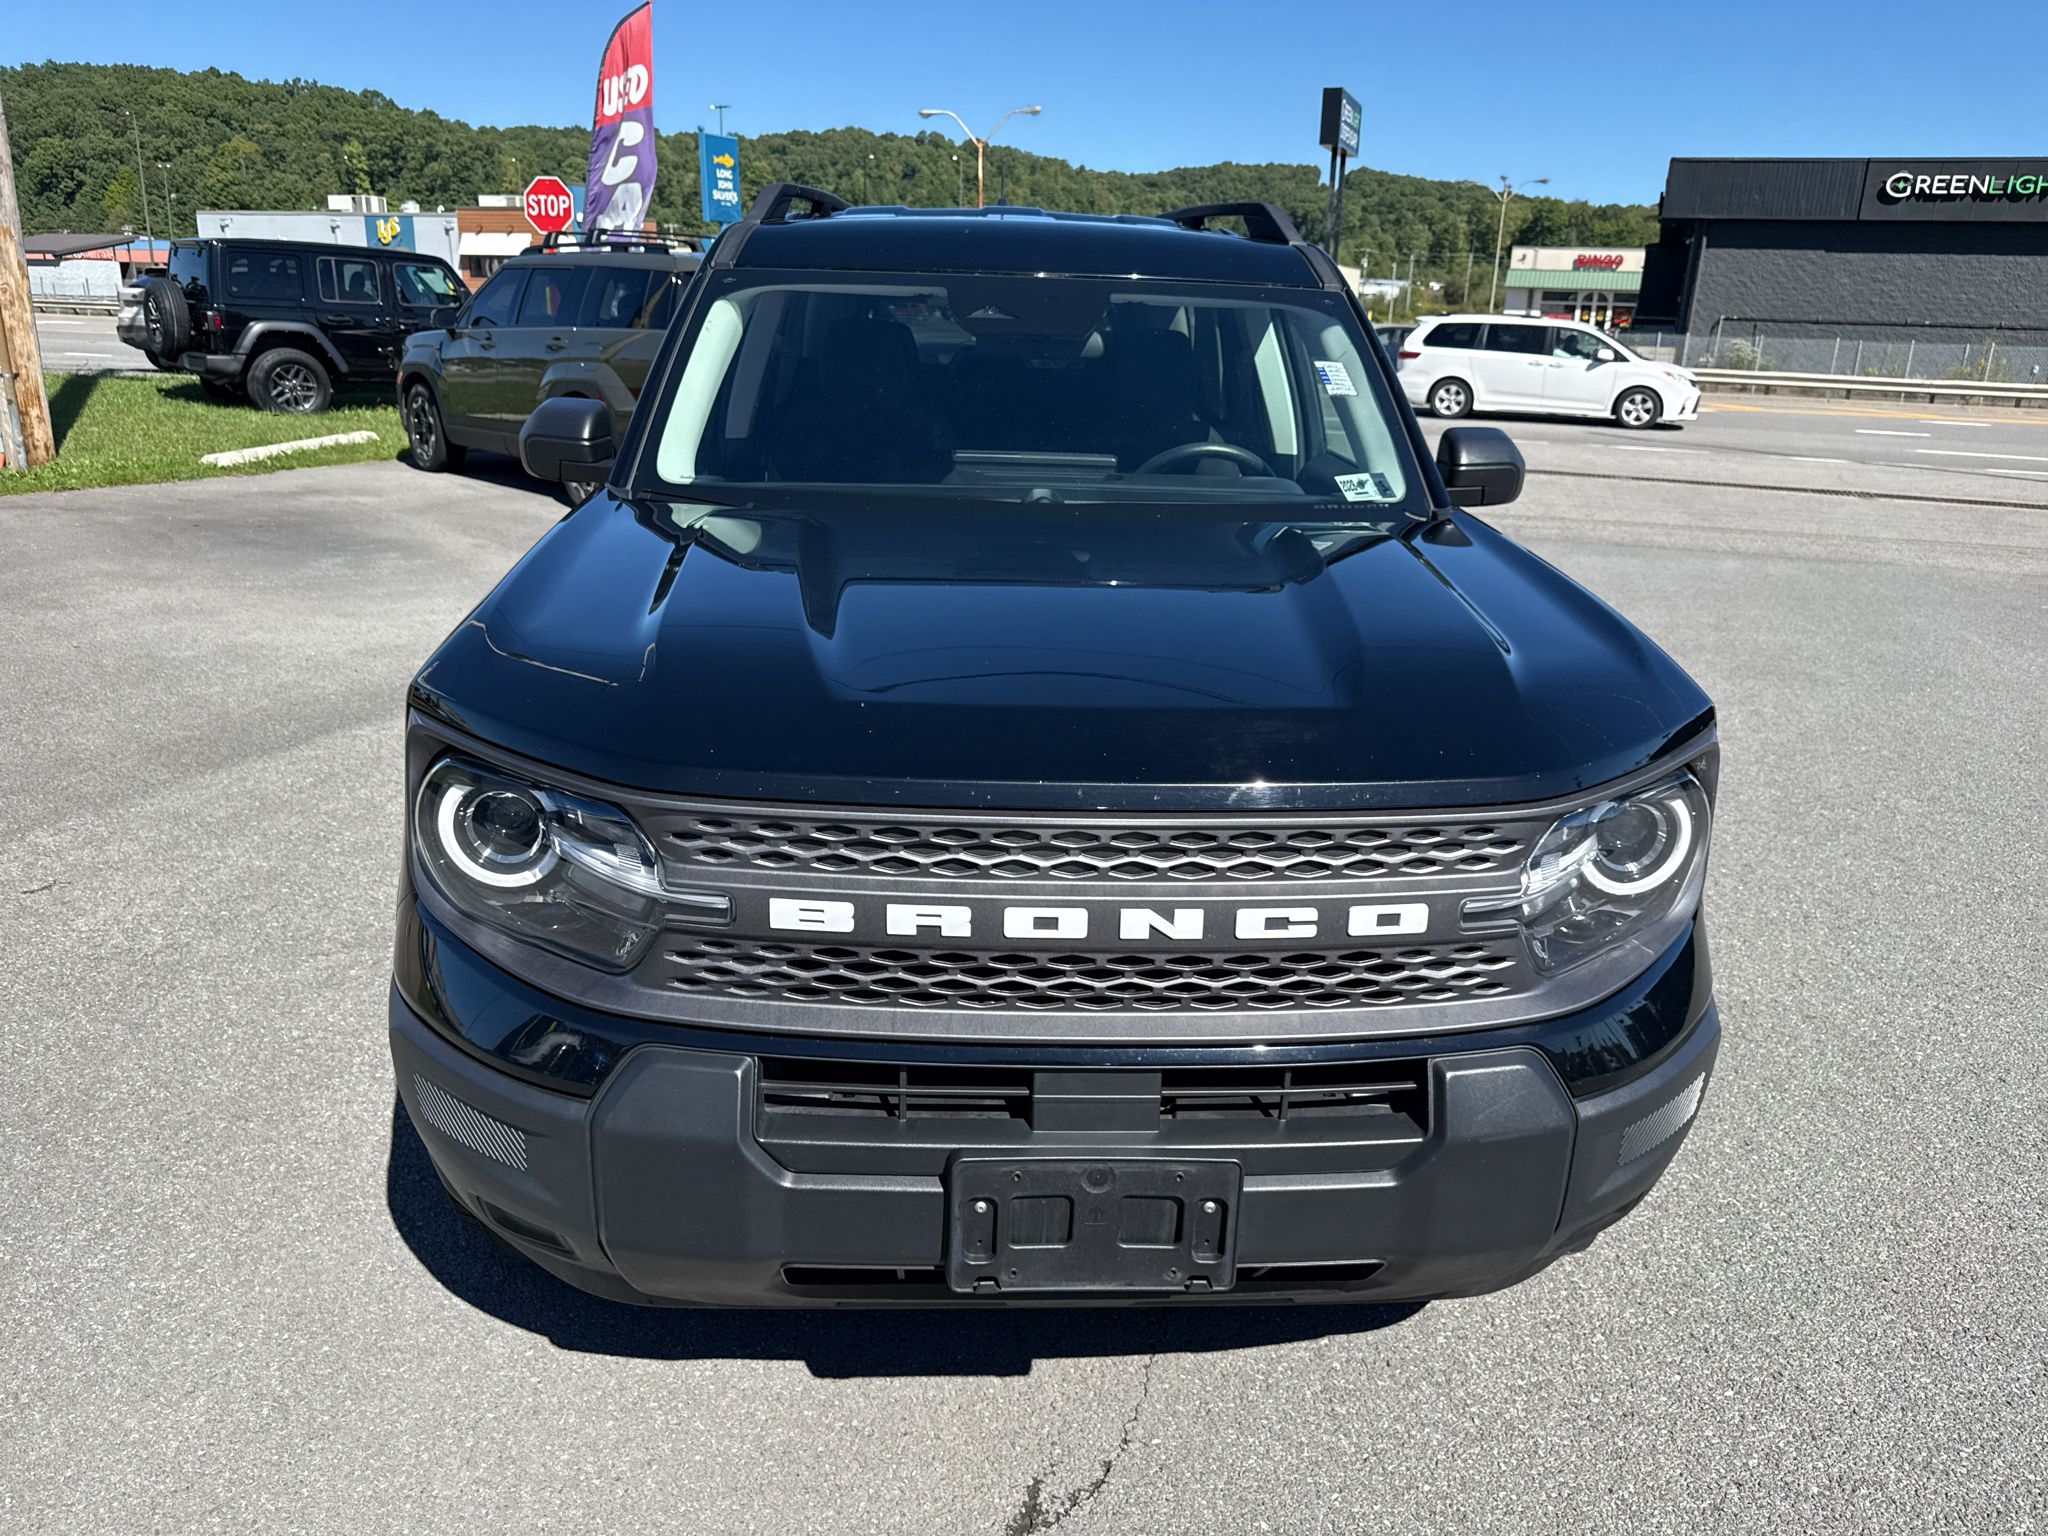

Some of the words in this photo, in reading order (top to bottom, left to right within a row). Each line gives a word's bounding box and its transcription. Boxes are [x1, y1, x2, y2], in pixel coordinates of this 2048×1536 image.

[528, 194, 570, 217] STOP
[1576, 254, 1623, 267] BINGO
[769, 897, 1429, 940] BRONCO
